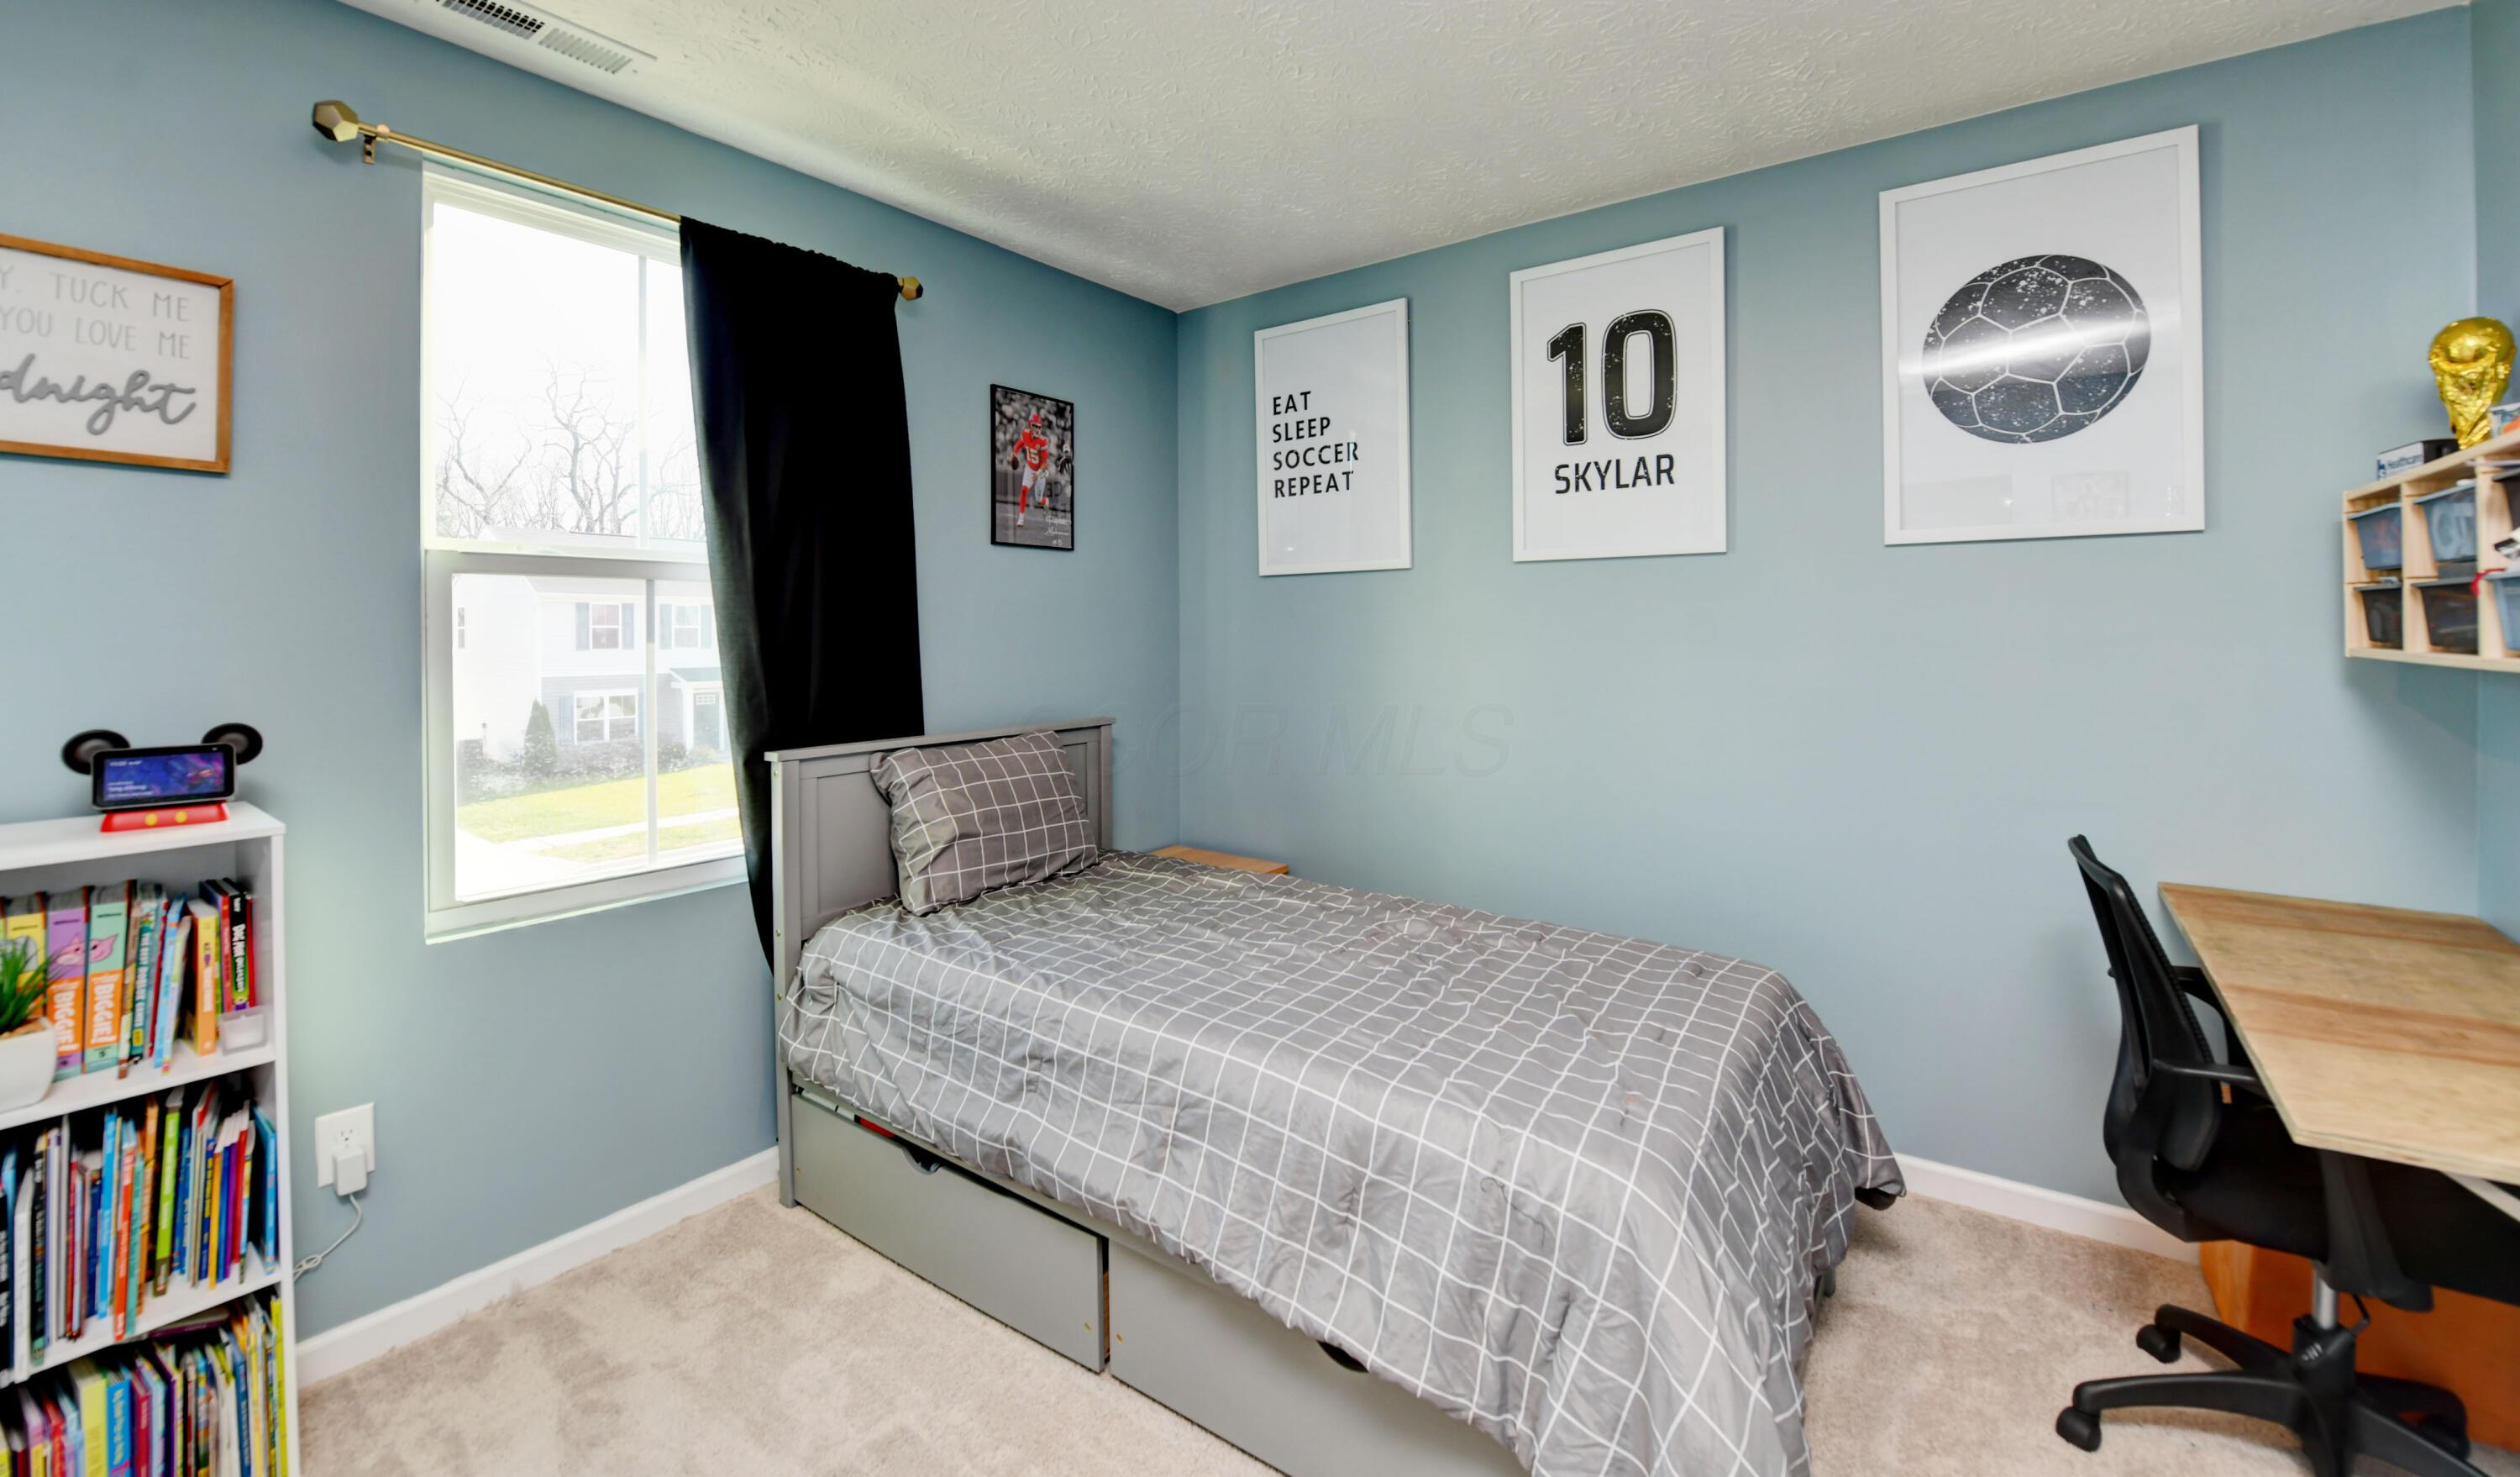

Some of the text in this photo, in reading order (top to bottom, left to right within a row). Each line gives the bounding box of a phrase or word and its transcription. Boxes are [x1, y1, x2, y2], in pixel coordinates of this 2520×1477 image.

[49, 271, 129, 309] TUCK
[153, 292, 191, 322] ME
[0, 306, 191, 360] YOU LOVE ME
[1546, 308, 1678, 446] 10
[1273, 391, 1311, 416] EAT
[1273, 417, 1331, 443] SLEEP
[1026, 446, 1039, 465] 15
[1273, 442, 1359, 470] SOCCER
[1274, 470, 1354, 498] REPEAT
[1555, 454, 1675, 494] SKYLAR
[90, 982, 118, 1044] BIGGIE!
